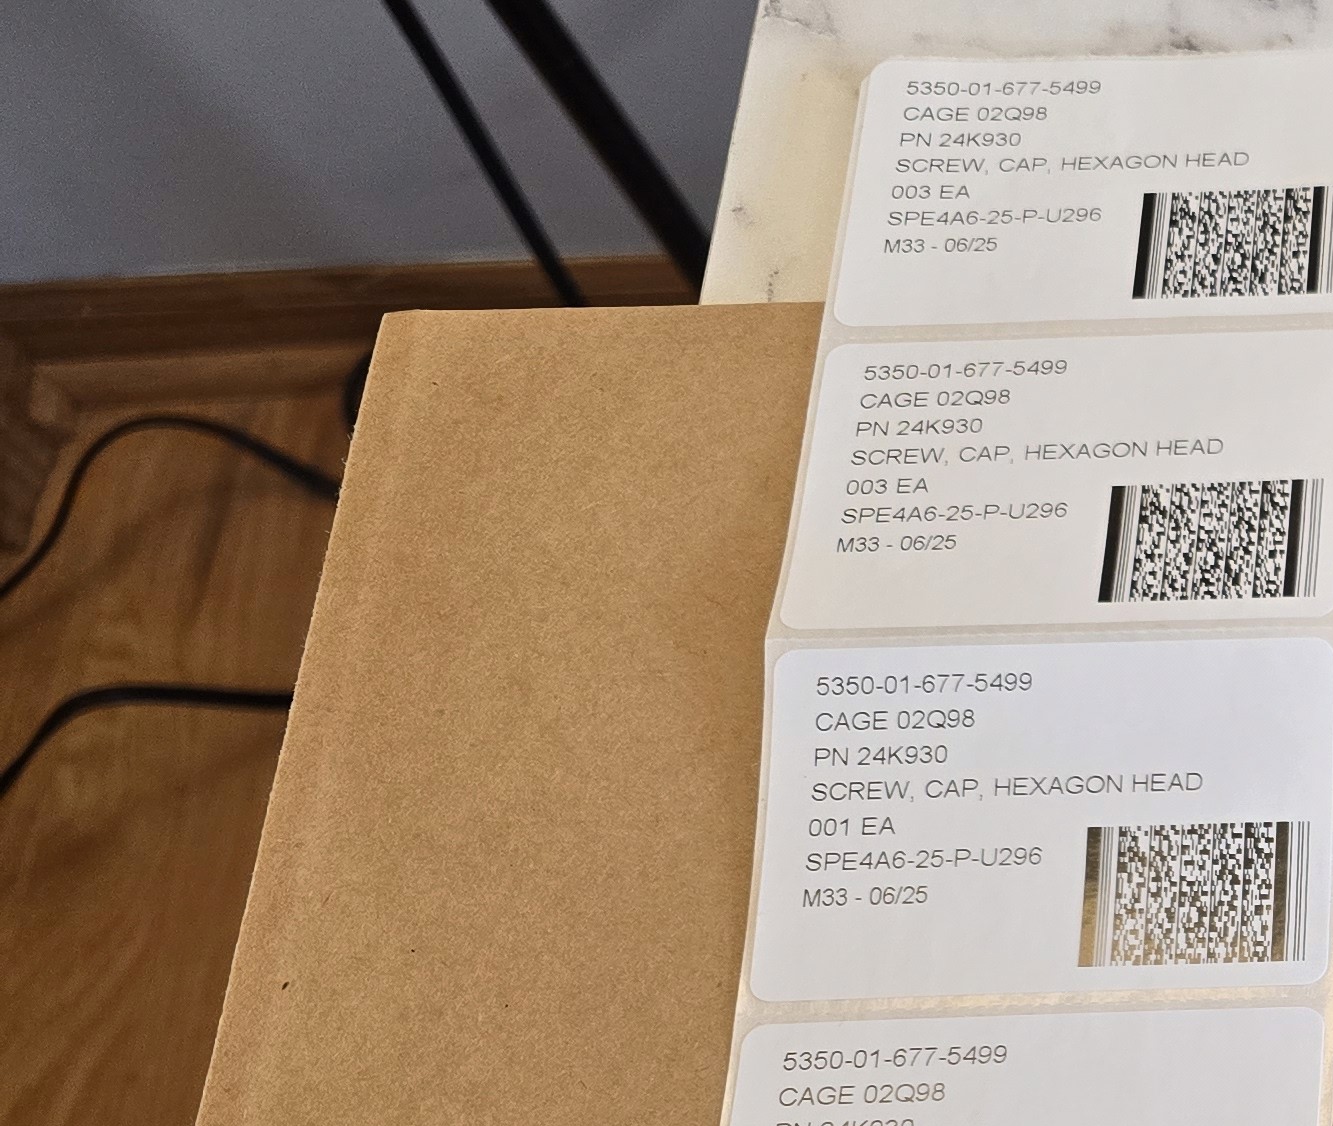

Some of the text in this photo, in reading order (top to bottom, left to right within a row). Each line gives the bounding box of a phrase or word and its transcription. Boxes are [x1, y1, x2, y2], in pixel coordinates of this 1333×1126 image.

[906, 80, 1102, 97] 5350-01-677-5499
[903, 105, 1048, 122] CAGE 02Q98
[899, 131, 1022, 148] PN 24K930
[895, 151, 1250, 176] SCREW, CAP, HEXAGON HEAD
[891, 183, 971, 200] 003 EA
[886, 207, 1103, 227] SPE4A6-25-P-U296
[883, 236, 998, 254] M33 06/25
[863, 359, 1068, 382] 5350-01-677-5499
[859, 388, 1011, 410] CAGE 02Q98
[855, 416, 984, 438] PN 24K930
[850, 437, 1224, 467] SCREW, CAP, HEXAGON HEAD
[845, 477, 929, 496] 003 EA
[840, 501, 1069, 529] SPE4A6-25-P-U296
[836, 533, 958, 553] M33 06/25
[816, 671, 1033, 697] 5350-01-677-5499
[815, 708, 976, 732] CAGE 02Q98
[814, 743, 949, 767] PN 24K930
[810, 772, 1204, 803] SCREW, CAP, HEXAGON HEAD
[808, 816, 897, 838] 001 EA
[805, 846, 1043, 872] SPE4A6-25-P-U296
[802, 884, 929, 908] M33 06/25
[782, 1044, 1008, 1072] 5350-01-677-5499
[778, 1082, 946, 1107] CAGE 02Q98
